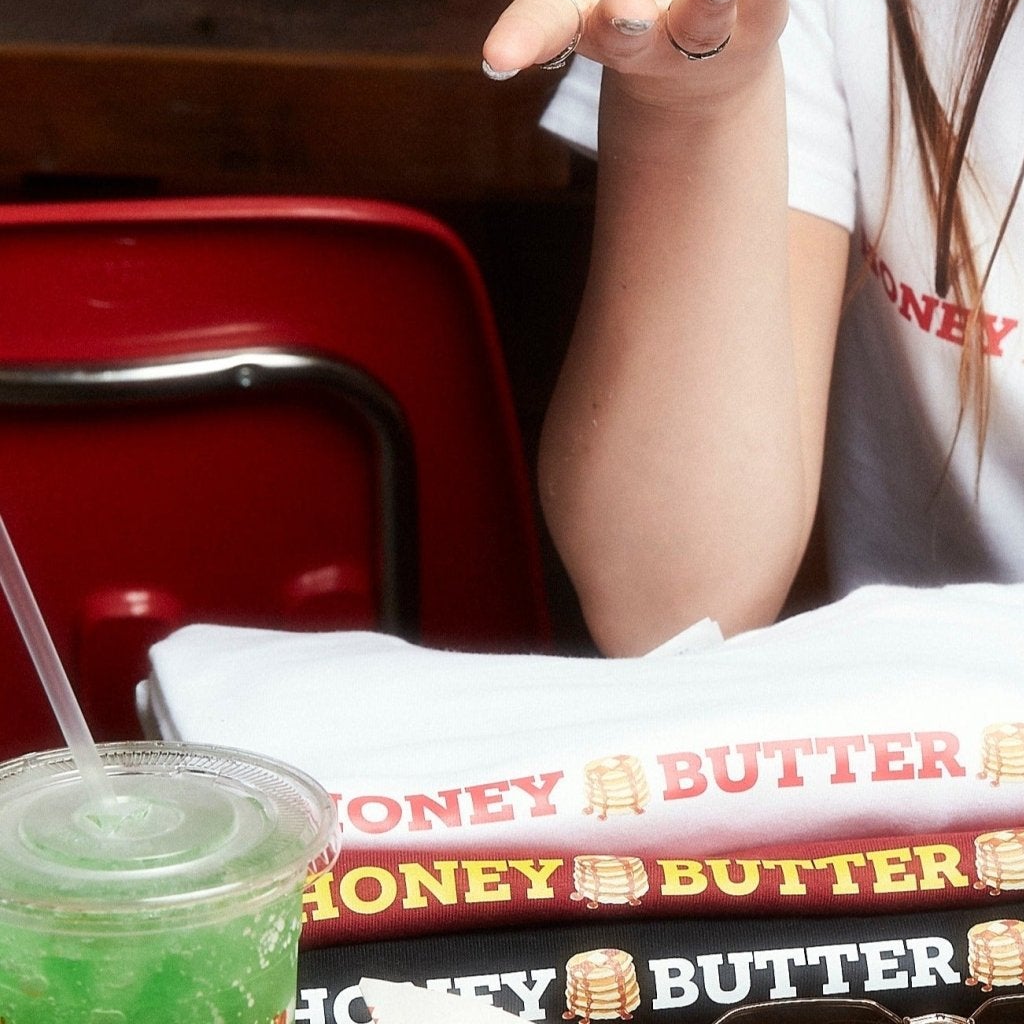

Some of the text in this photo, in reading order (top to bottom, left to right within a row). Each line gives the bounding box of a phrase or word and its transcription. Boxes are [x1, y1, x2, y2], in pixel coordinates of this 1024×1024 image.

[329, 770, 565, 834] ONEY
[657, 730, 967, 801] BUTTER
[656, 843, 968, 896] BUTTER
[648, 936, 960, 1011] BUTTER
